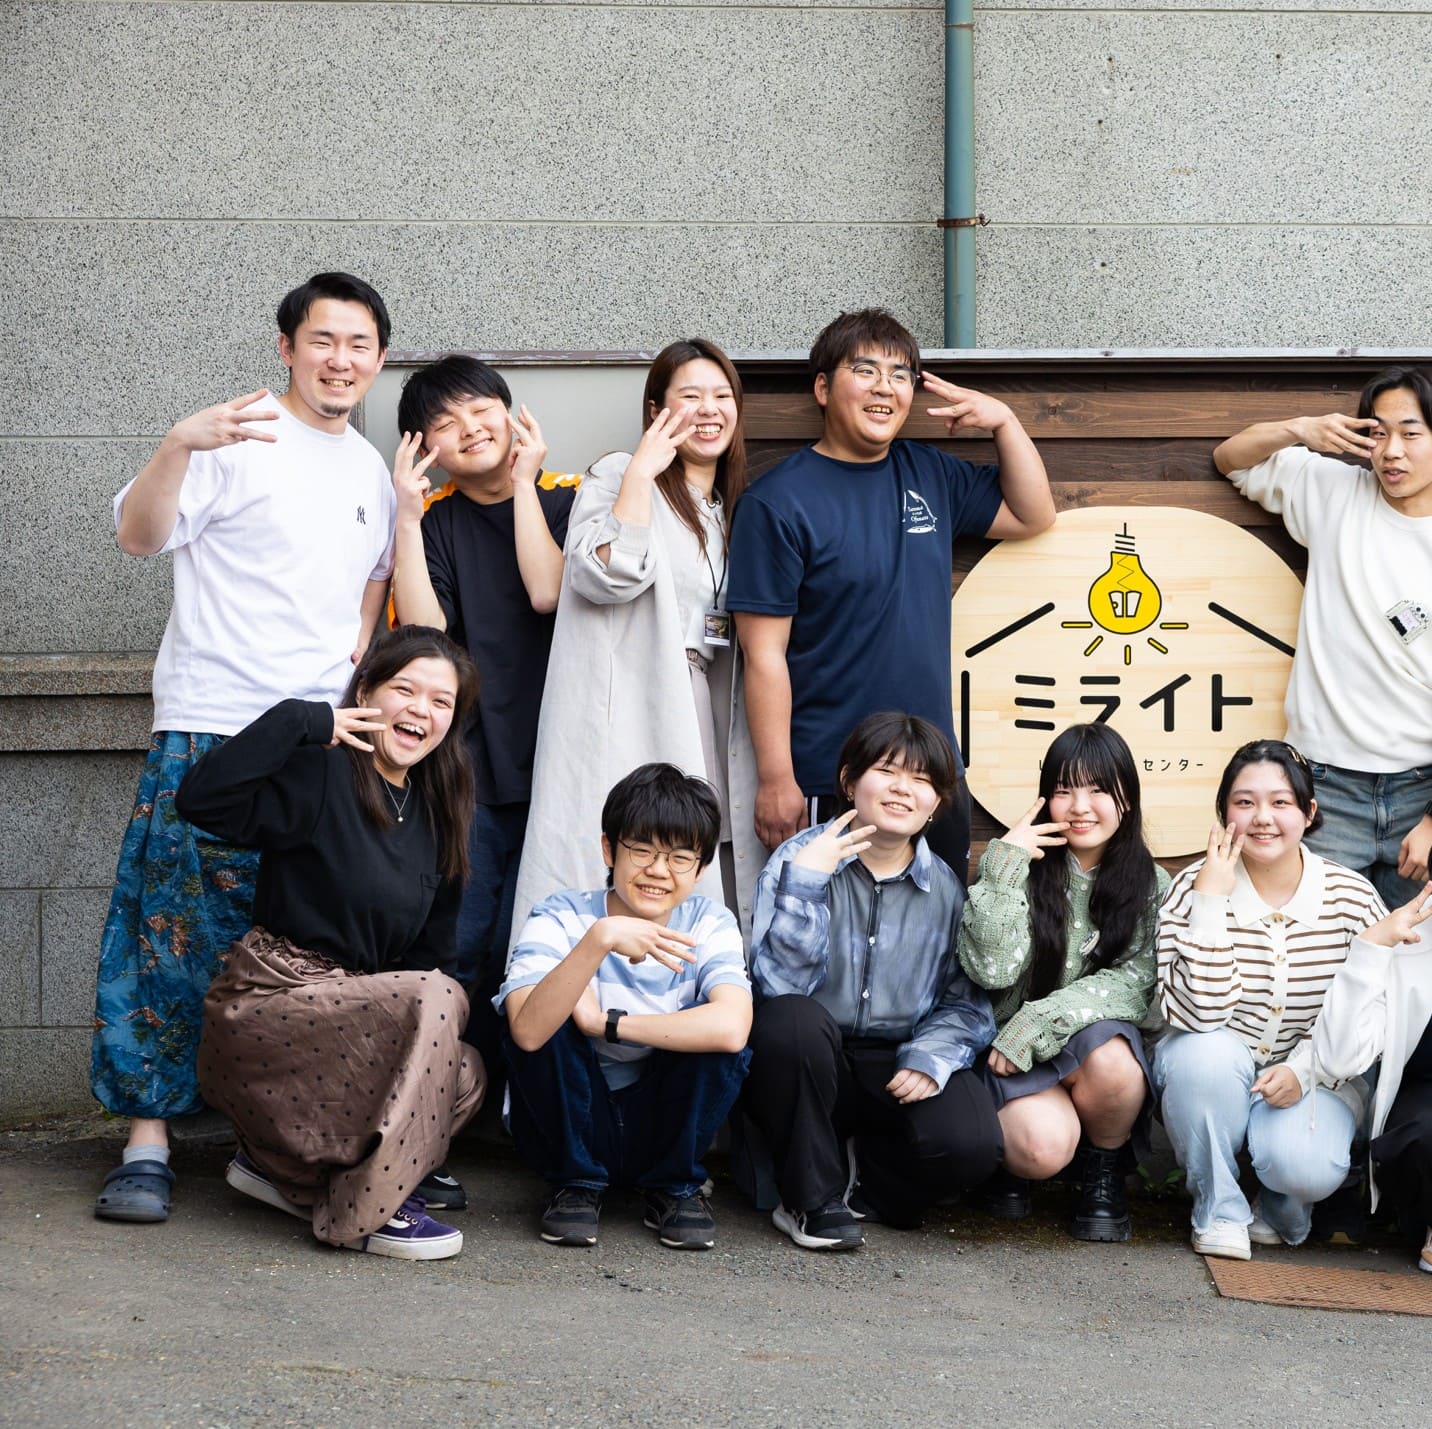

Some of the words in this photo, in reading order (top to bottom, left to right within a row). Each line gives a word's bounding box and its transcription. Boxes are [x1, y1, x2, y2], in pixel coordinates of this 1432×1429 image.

[1014, 673, 1253, 732] ミライト
[1143, 758, 1204, 772] センター
